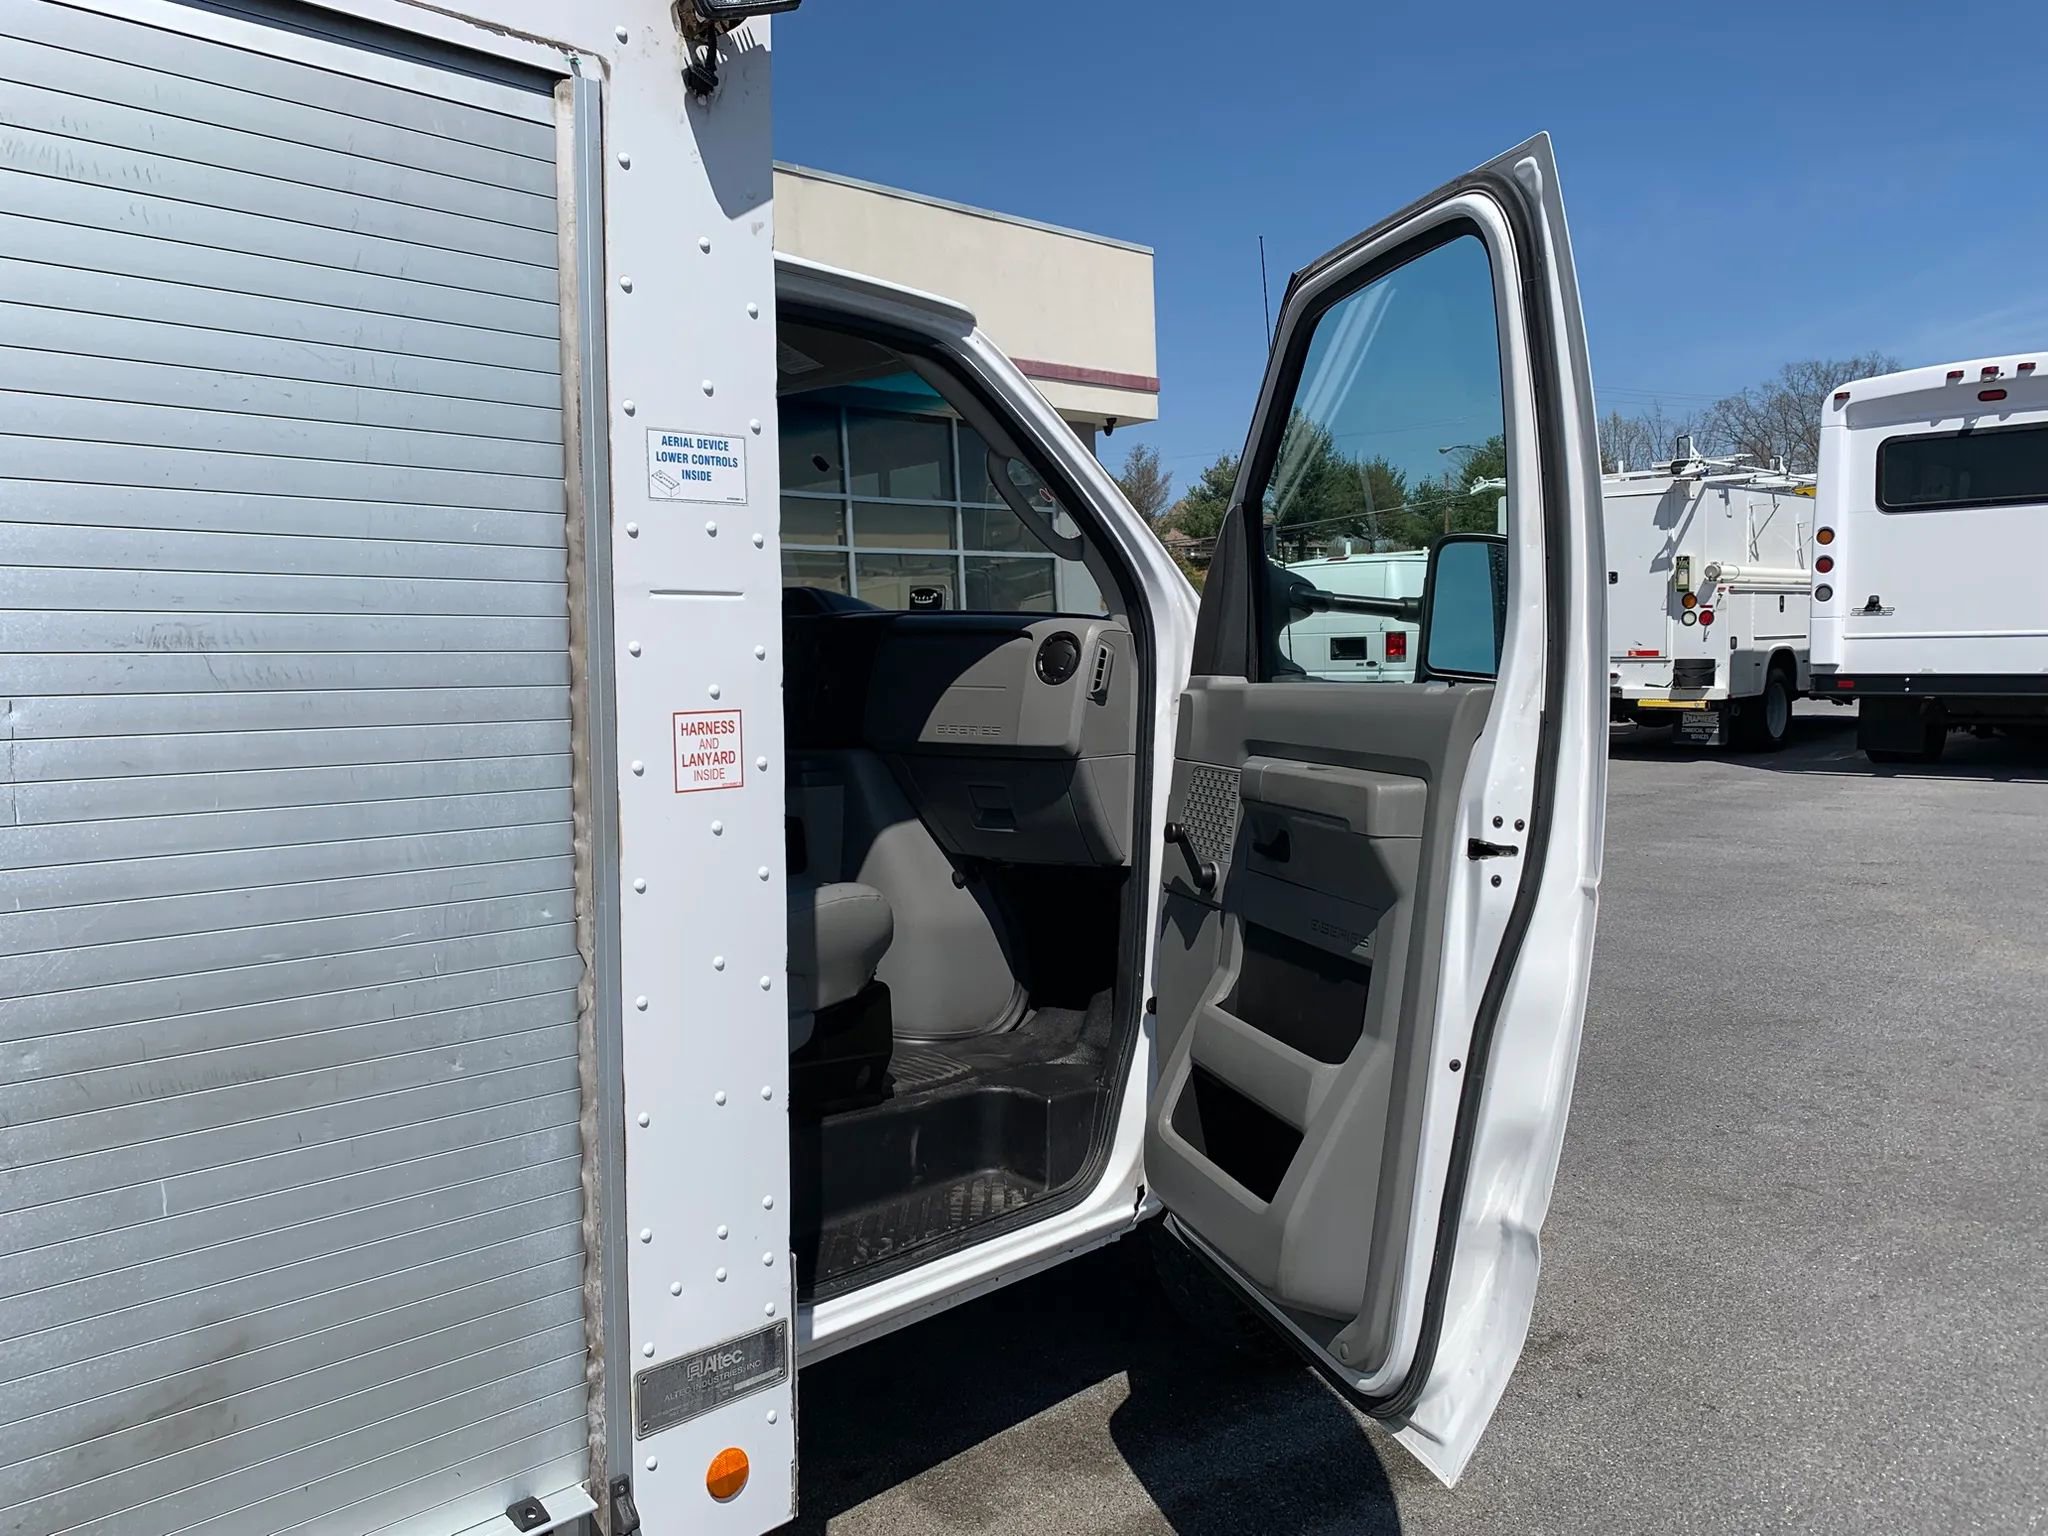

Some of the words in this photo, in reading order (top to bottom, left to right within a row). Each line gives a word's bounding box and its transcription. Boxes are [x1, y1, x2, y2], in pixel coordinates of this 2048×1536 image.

[661, 435, 694, 448] AERIAL
[697, 438, 729, 451] DEVICE
[656, 451, 689, 464] LOWER
[691, 453, 738, 468] CONTROLS
[681, 469, 712, 481] INSIDE
[681, 720, 735, 736] HARNESS
[699, 737, 720, 750] AND
[682, 751, 736, 767] LANYARD
[693, 768, 726, 781] INSIDE
[703, 1349, 743, 1376] Altec
[664, 1386, 691, 1402] ALTEC
